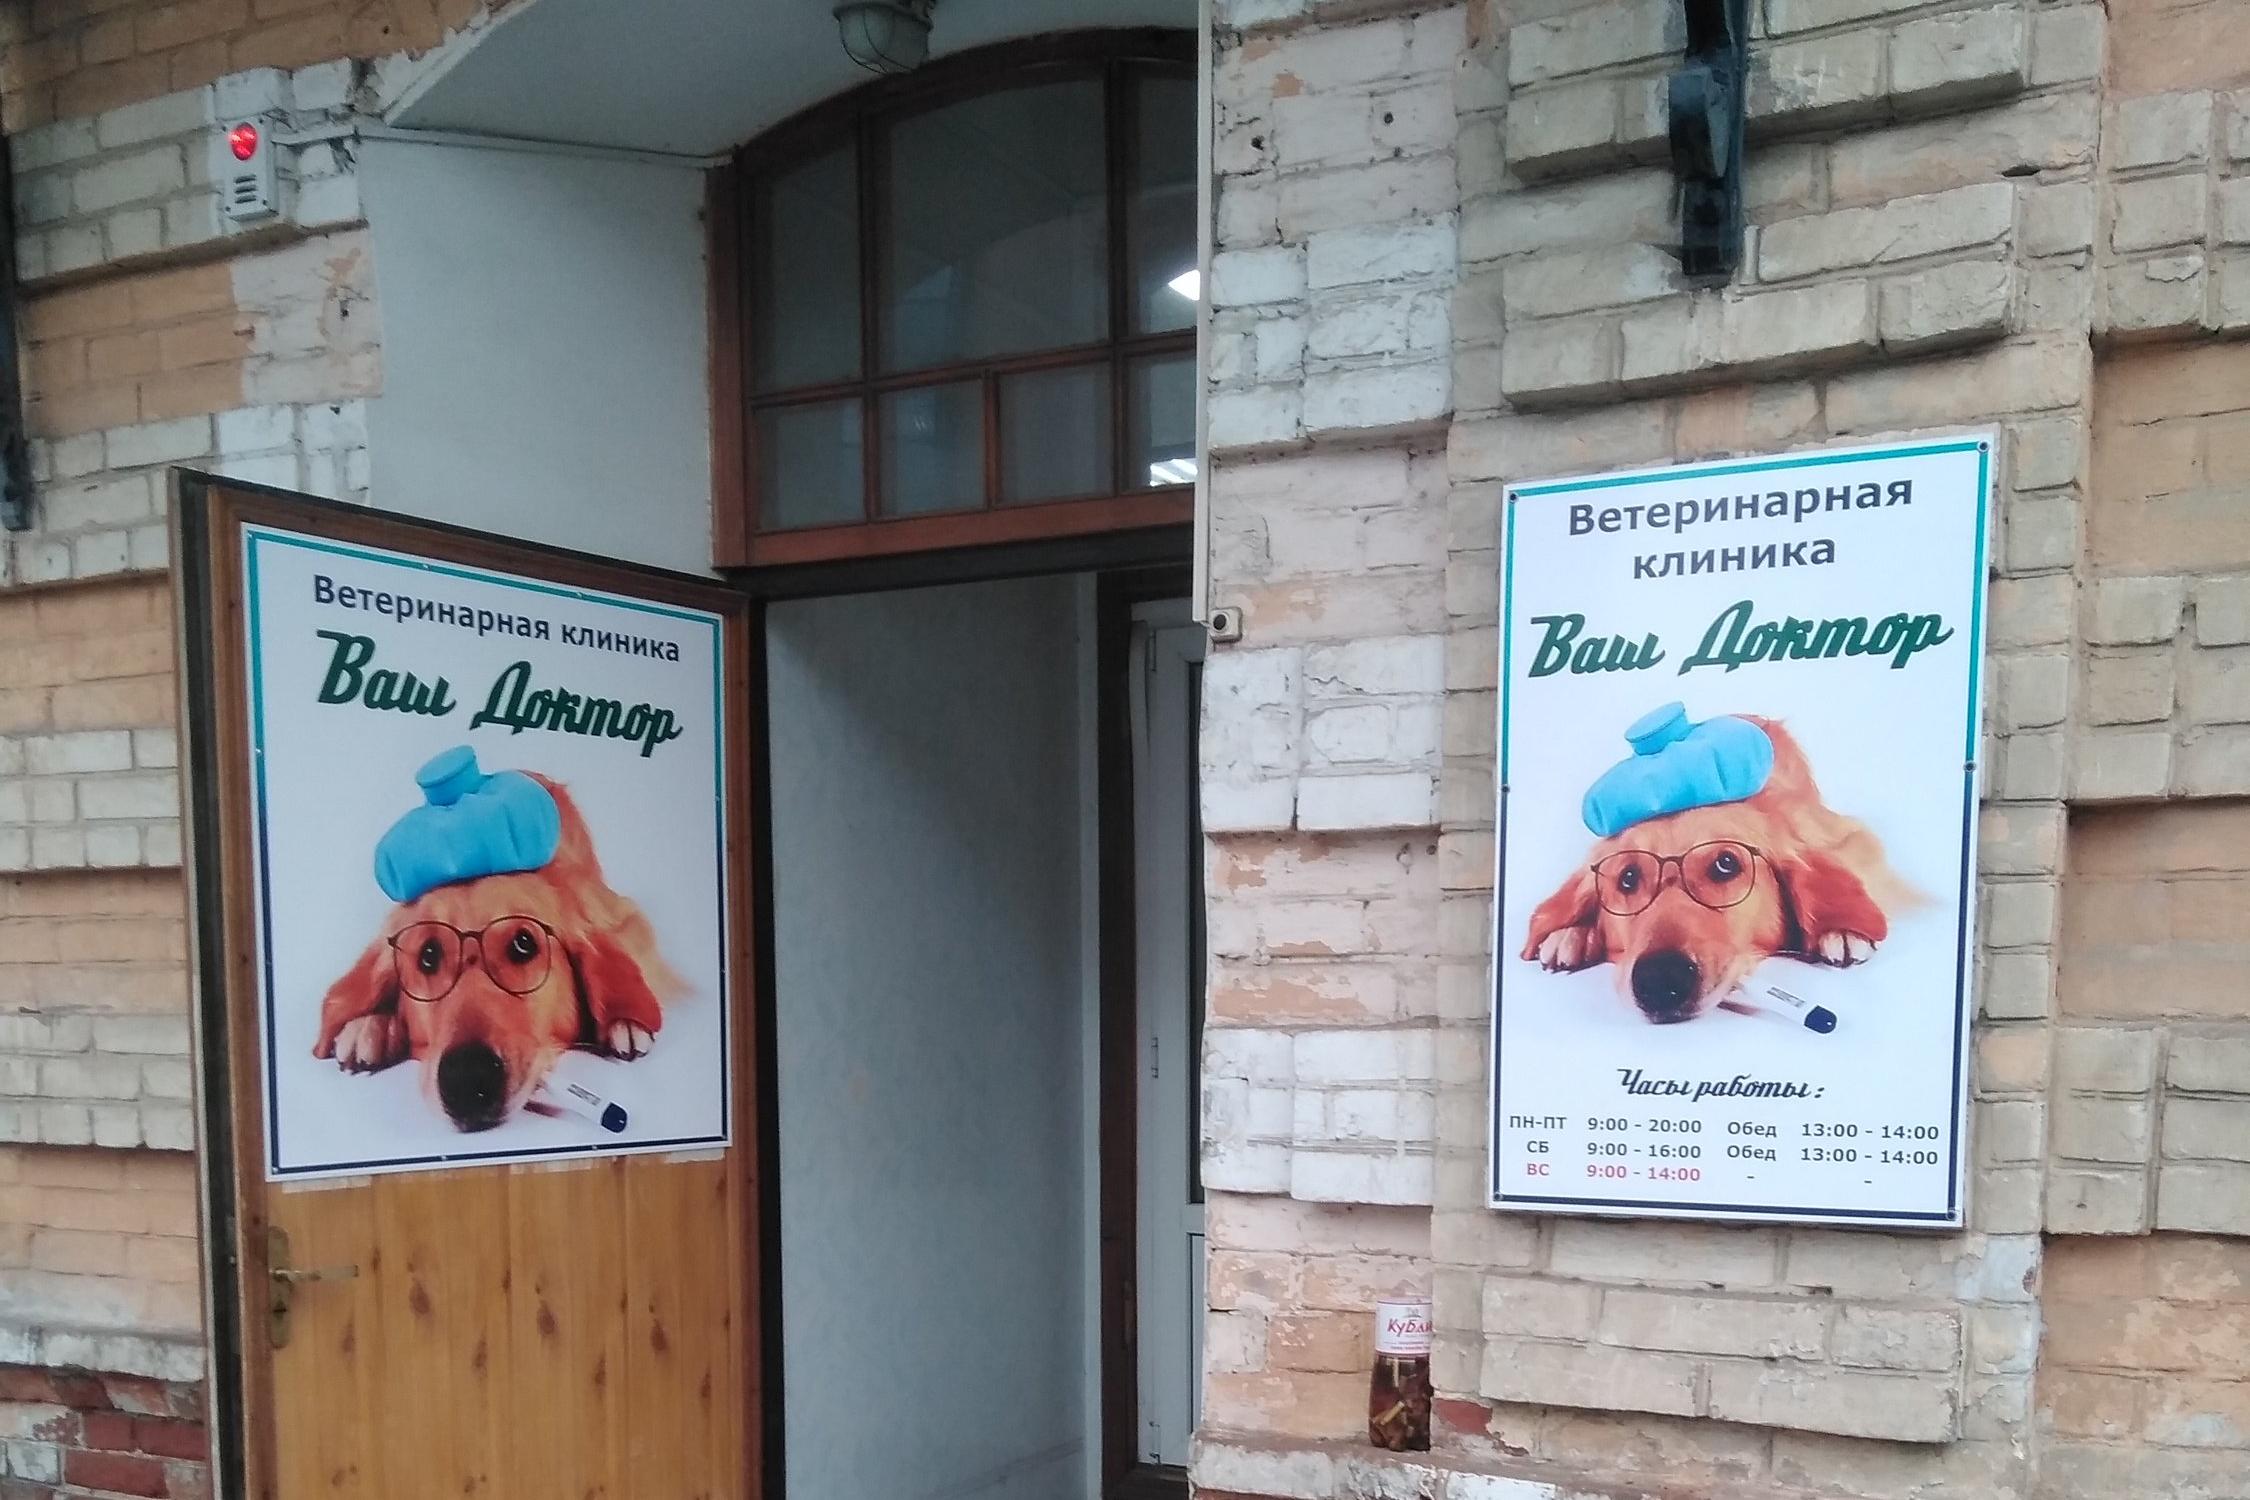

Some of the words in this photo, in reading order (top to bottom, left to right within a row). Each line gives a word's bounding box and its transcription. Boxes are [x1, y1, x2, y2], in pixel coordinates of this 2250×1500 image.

[1569, 479, 1912, 535] Ветеринарная
[1633, 538, 1836, 580] клиника
[314, 574, 550, 638] Ветеринарная
[561, 624, 680, 662] клиника
[1528, 613, 1666, 678] Ваш
[1677, 599, 1955, 676] Доктор
[316, 629, 457, 717] Ваш
[468, 660, 684, 758] Доктор
[1617, 1068, 1690, 1096] Часы
[1692, 1074, 1825, 1102] работы:
[1509, 1115, 1567, 1130] ПН-ПТ
[1587, 1117, 1628, 1132] 9:00
[1649, 1118, 1702, 1134] 20:00
[1727, 1121, 1777, 1138] Обед
[1801, 1123, 1858, 1138] 13:00
[1881, 1125, 1939, 1140] 14:00
[1526, 1141, 1549, 1153] СБ
[1587, 1142, 1628, 1156] 9:00
[1649, 1144, 1701, 1159] 16:00
[1726, 1144, 1777, 1162] Обед
[1801, 1147, 1857, 1163] 13:00
[1881, 1149, 1938, 1165] 14:00
[1527, 1163, 1549, 1176] ВС
[1587, 1165, 1627, 1179] 9:00
[1648, 1166, 1701, 1182] 14:00
